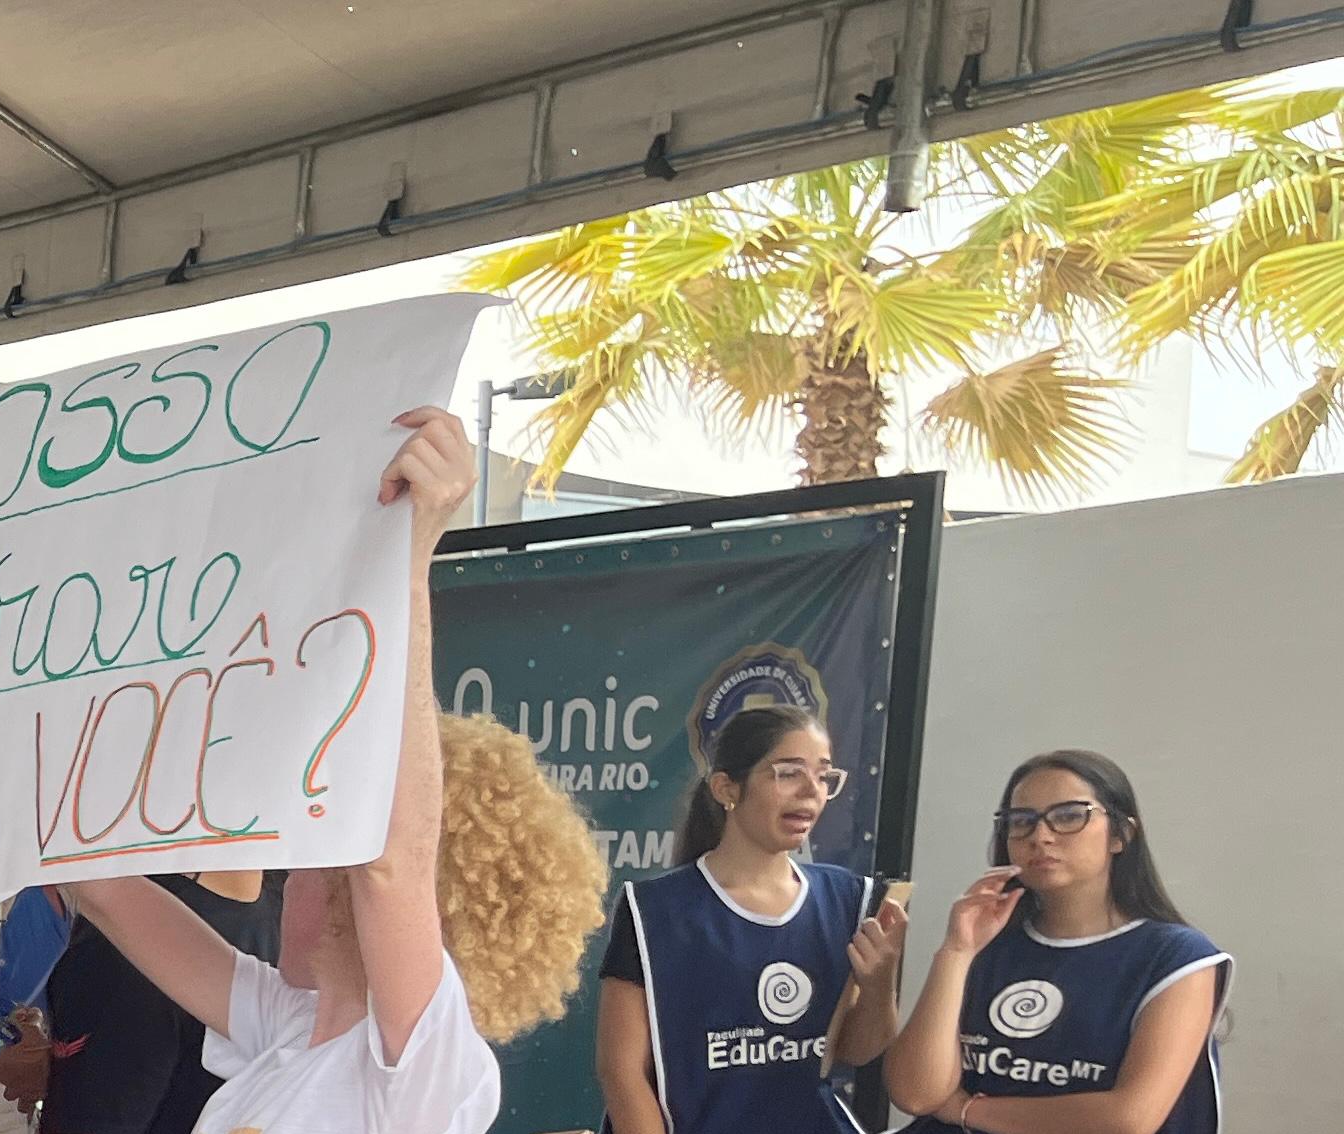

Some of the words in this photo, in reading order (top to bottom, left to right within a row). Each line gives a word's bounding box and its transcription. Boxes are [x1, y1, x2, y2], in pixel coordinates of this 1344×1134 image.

[519, 676, 660, 753] unic
[599, 762, 649, 791] RIO
[708, 1035, 826, 1070] EduCare
[1071, 1059, 1107, 1082] MT
